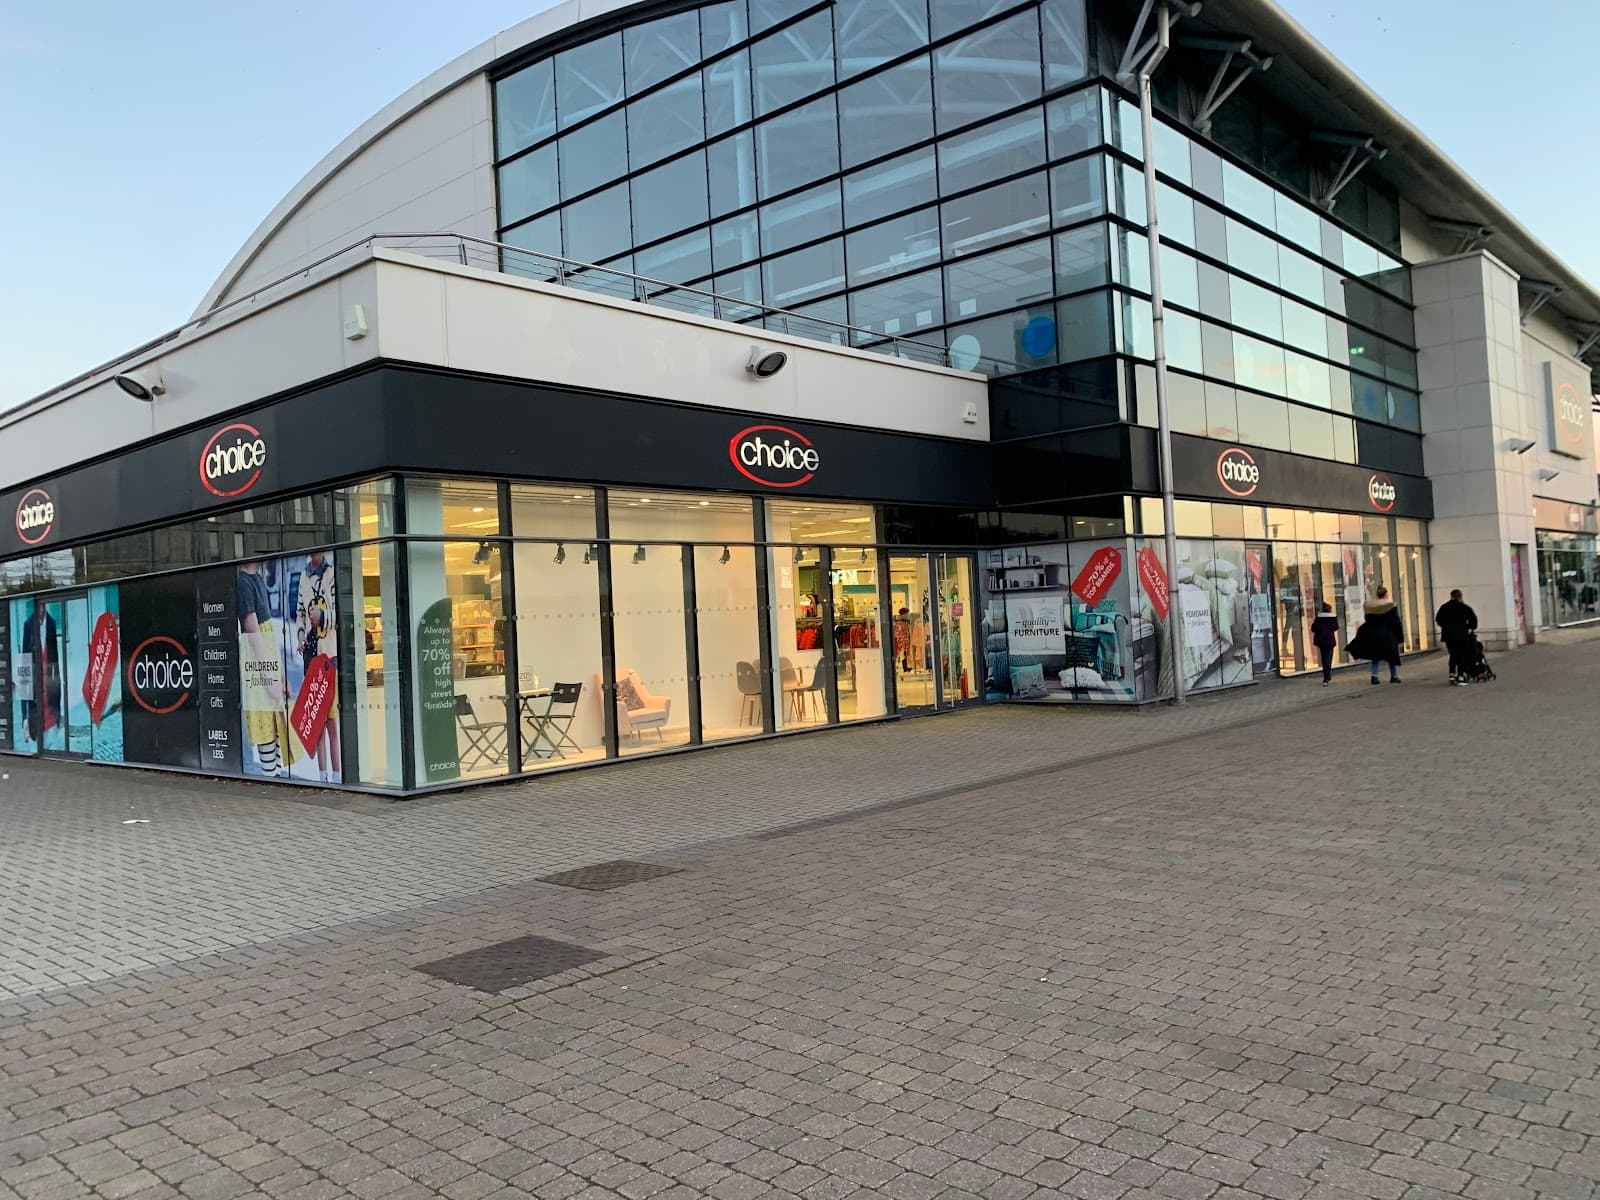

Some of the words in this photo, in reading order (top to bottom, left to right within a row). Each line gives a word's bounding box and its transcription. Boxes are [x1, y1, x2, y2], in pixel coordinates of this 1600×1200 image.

[205, 438, 266, 479] choice
[740, 436, 820, 471] choice
[1221, 457, 1260, 484] choice
[19, 500, 54, 530] choice
[1088, 562, 1104, 585] 70%
[1086, 585, 1097, 599] TOP
[1095, 561, 1115, 587] BRANDS
[203, 602, 224, 614] Women
[1022, 616, 1051, 629] quality
[208, 626, 220, 636] Men
[424, 626, 450, 636] Always
[1014, 627, 1060, 637] FURNITURE
[204, 649, 227, 661] Children
[422, 648, 451, 661] 70%
[134, 653, 193, 689] choice
[245, 661, 279, 672] CHILDRENS
[434, 662, 451, 676] off
[208, 673, 225, 685] Home
[250, 674, 273, 689] fashion
[435, 679, 452, 688] high
[304, 678, 319, 717] 70%
[431, 690, 453, 698] street
[211, 696, 224, 708] Gifts
[302, 719, 312, 739] TOP
[311, 678, 328, 720] BRANDS
[208, 729, 227, 741] LABELS
[213, 750, 224, 760] LESS
[430, 761, 456, 772] choice
